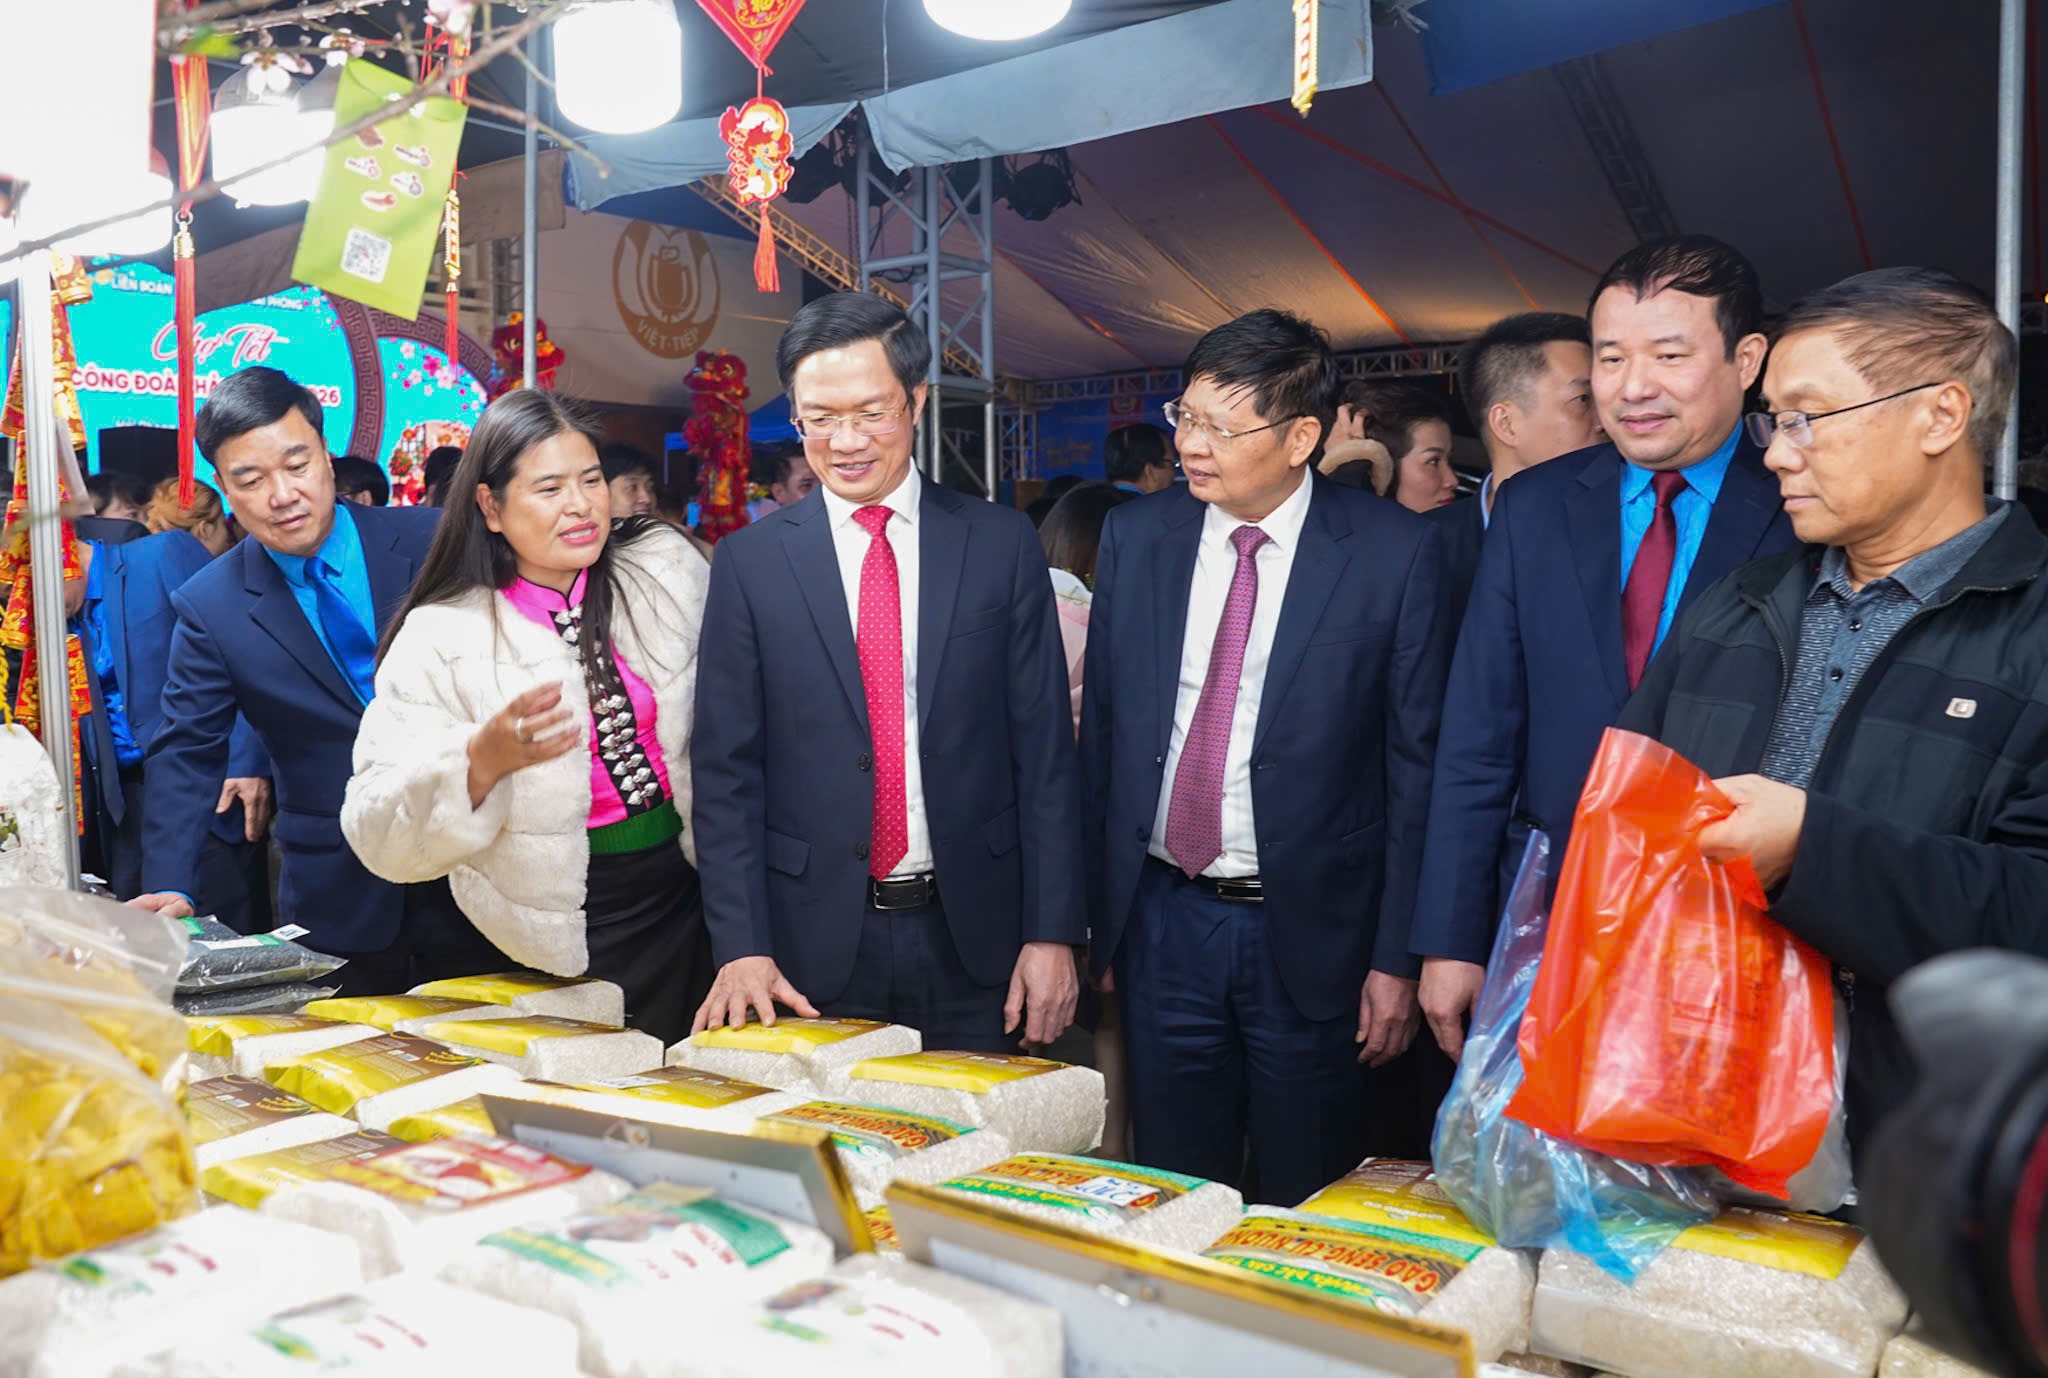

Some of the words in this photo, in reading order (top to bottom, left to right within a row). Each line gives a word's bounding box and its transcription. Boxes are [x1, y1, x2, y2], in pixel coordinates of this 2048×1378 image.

[224, 323, 290, 368] Tết
[71, 365, 129, 389] CÔNG
[134, 369, 178, 393] ĐOÀ
